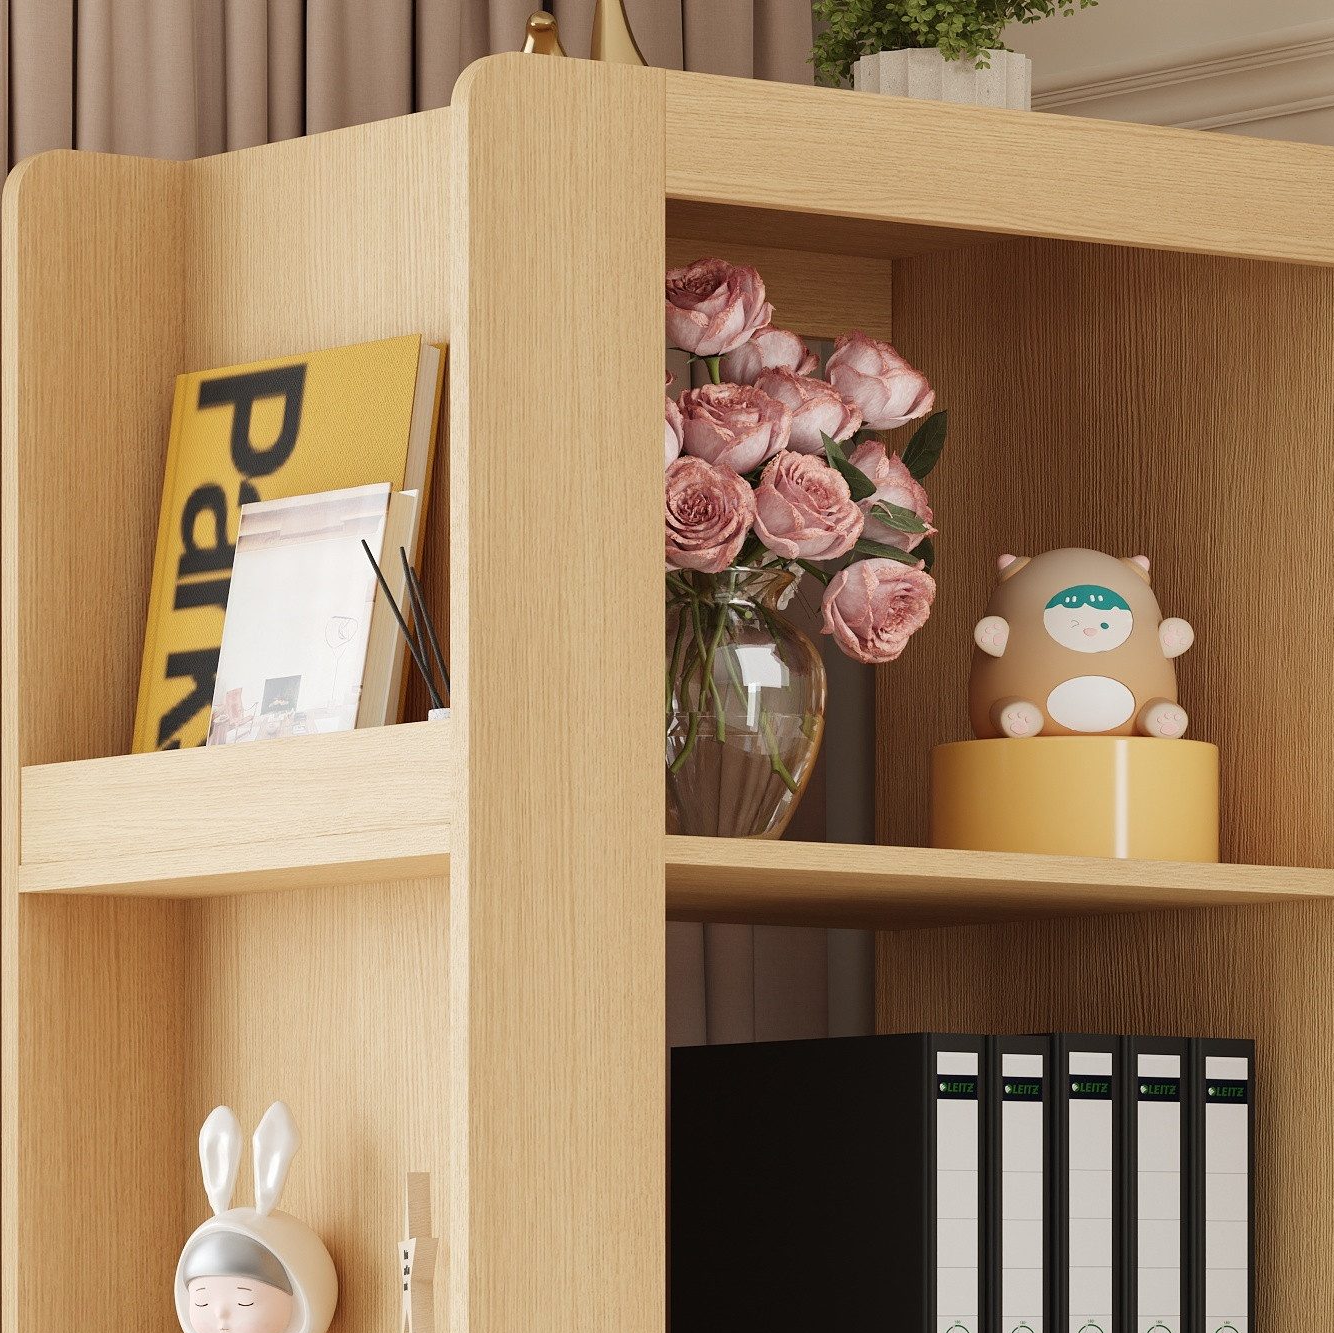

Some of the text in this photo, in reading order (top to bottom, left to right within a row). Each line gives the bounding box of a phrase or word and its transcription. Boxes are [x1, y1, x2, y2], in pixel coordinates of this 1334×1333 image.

[156, 363, 308, 751] Park
[947, 1083, 974, 1093] LEITZ
[1013, 1085, 1039, 1095] LEITZ
[1080, 1083, 1108, 1093] LEITZ
[1148, 1085, 1176, 1095] LEITZ
[1217, 1087, 1244, 1097] LEITZ
